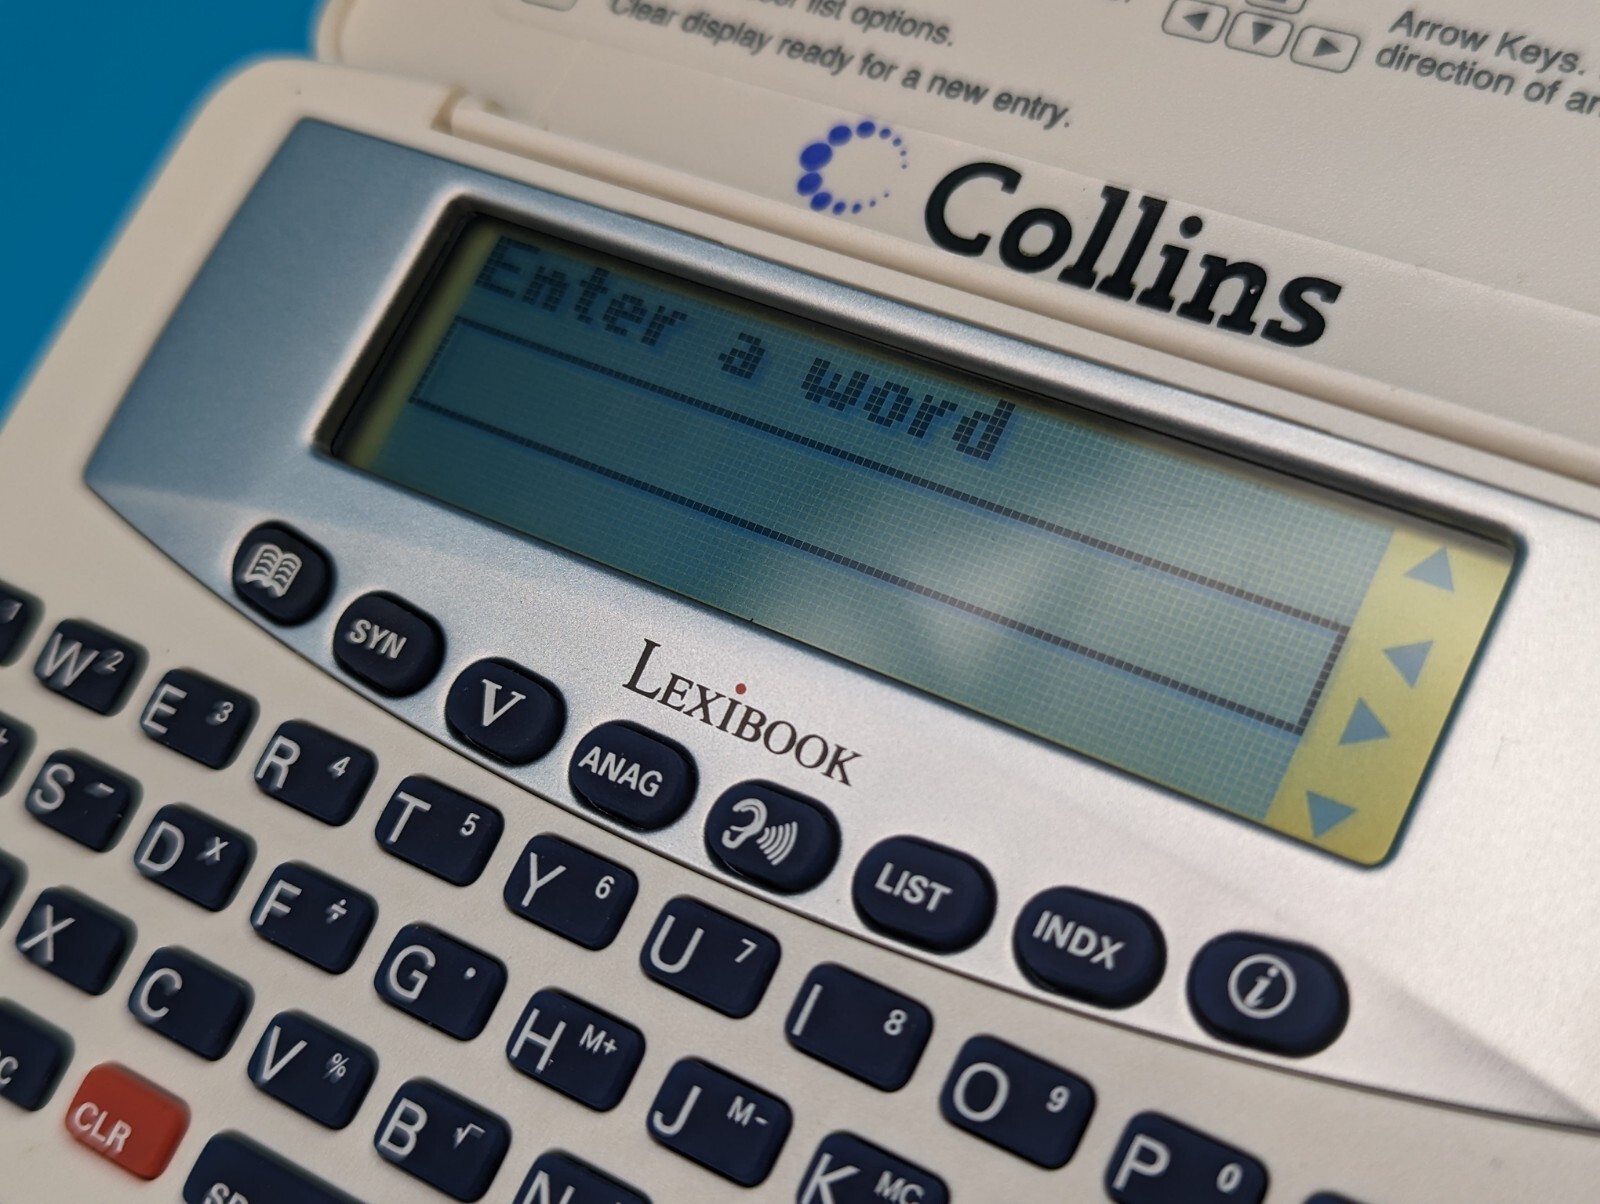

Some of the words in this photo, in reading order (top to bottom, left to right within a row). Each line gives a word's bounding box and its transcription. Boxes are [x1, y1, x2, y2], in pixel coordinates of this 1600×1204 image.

[850, 4, 953, 47] options.
[1387, 10, 1490, 52] Arrow
[1493, 31, 1585, 76] Keys.
[680, 12, 774, 56] display
[776, 36, 854, 76] ready
[857, 52, 898, 81] for
[901, 68, 921, 91] a
[926, 72, 990, 106] new
[992, 91, 1070, 130] entry.
[1375, 44, 1516, 96] direction
[1523, 79, 1562, 105] of
[924, 161, 1343, 348] Collins
[474, 234, 689, 347] Enter
[717, 332, 766, 380] a
[800, 356, 1016, 461] word
[36, 632, 99, 689] W
[102, 649, 125, 673] 2
[349, 618, 408, 660] SYN
[142, 683, 188, 736] E
[214, 701, 234, 724] 3
[479, 678, 526, 727] V
[34, 762, 76, 811] S
[254, 734, 301, 790] R
[331, 755, 352, 778] 4
[578, 745, 664, 798] ANAG
[389, 791, 432, 843] T
[459, 813, 480, 837] 5
[138, 819, 186, 873] D
[254, 878, 302, 927] F
[521, 851, 567, 908] Y
[594, 874, 615, 900] 6
[874, 861, 953, 914] LIST
[20, 904, 77, 963] X
[648, 914, 705, 974] U
[733, 937, 757, 963] 7
[1030, 909, 1127, 971] INDX
[138, 966, 184, 1020] C
[388, 944, 437, 1001] G
[509, 1008, 567, 1073] H
[883, 1008, 907, 1036] 8
[260, 1024, 308, 1082] V
[74, 1101, 132, 1153] CLR
[378, 1096, 429, 1157] B
[652, 1085, 702, 1136] J
[1046, 1085, 1070, 1114] 9
[801, 1153, 861, 1204] K
[1111, 1133, 1171, 1192] P
